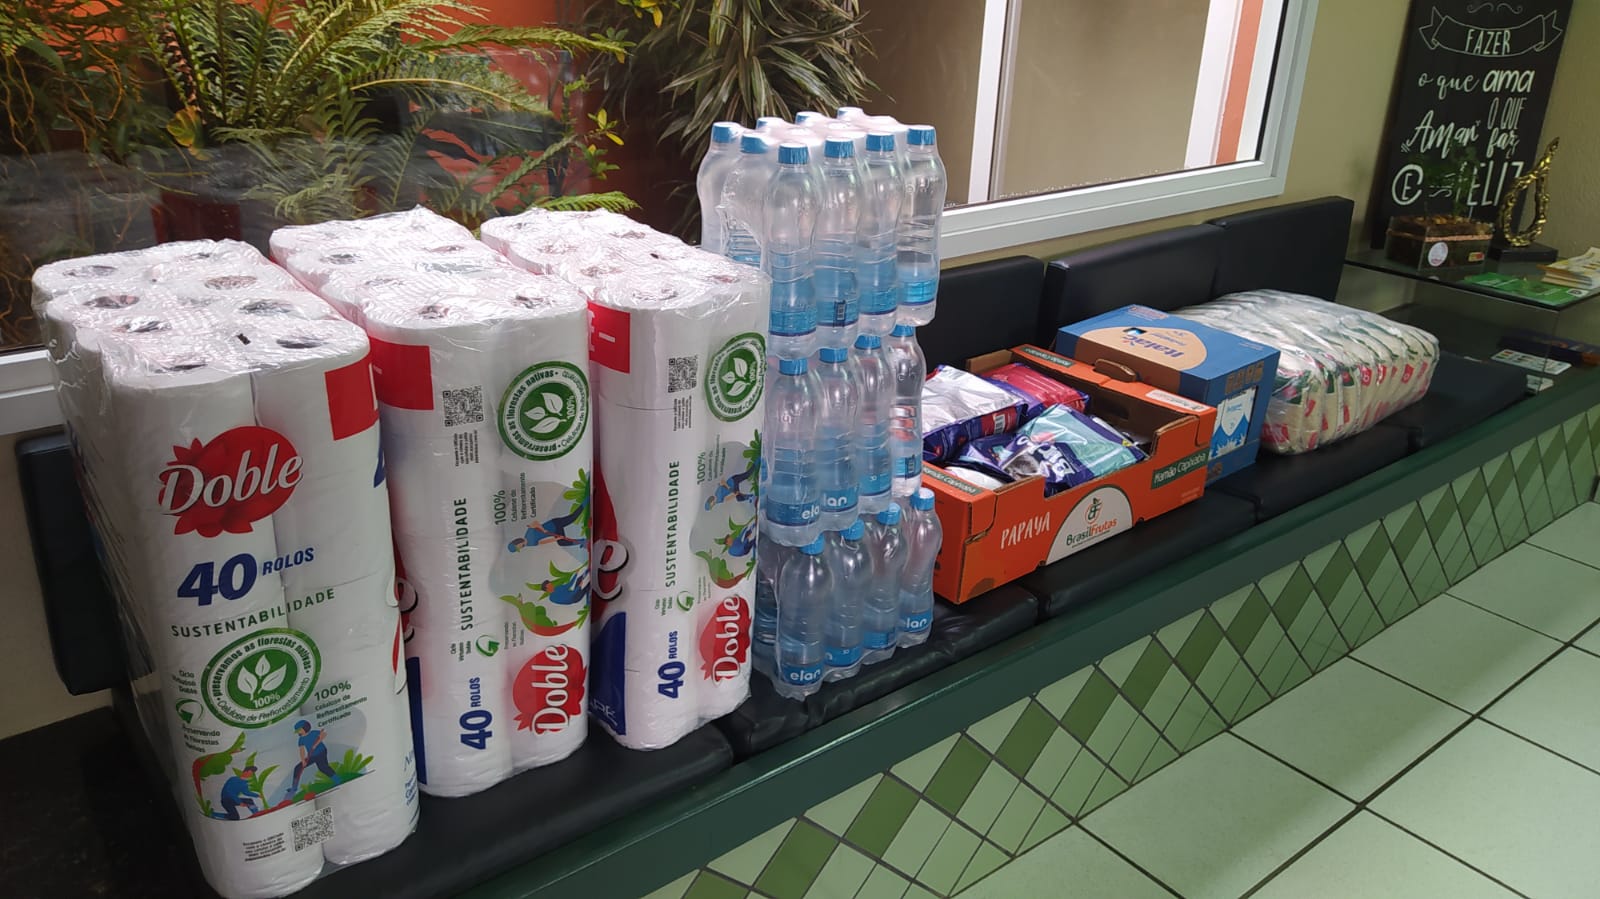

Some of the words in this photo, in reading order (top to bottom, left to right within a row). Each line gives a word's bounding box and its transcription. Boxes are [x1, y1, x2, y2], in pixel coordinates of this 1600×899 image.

[1465, 29, 1512, 56] FAZER
[1418, 72, 1433, 87] o
[1437, 74, 1480, 100] que
[1482, 69, 1536, 93] ama
[1487, 97, 1499, 130] O
[1501, 97, 1527, 130] QUE
[1486, 127, 1520, 159] faz
[157, 443, 304, 515] Doble
[697, 451, 707, 486] 100%
[493, 490, 506, 525] 100%
[801, 504, 820, 519] ela
[823, 493, 848, 507] lan
[665, 460, 680, 588] SUSTENTABILIDADE
[1000, 511, 1051, 550] PAPAYA
[177, 553, 257, 606] 40
[262, 548, 315, 576] ROLOS
[454, 498, 473, 631] SUSTENTABILIDADE
[171, 588, 335, 638] SUSTENTABILIDADE
[901, 617, 927, 629] lan
[668, 631, 678, 659] ROLOS
[712, 594, 741, 688] Doble
[211, 649, 243, 698] preservamos
[243, 643, 256, 653] as
[257, 636, 297, 648] florestas
[657, 661, 685, 699] 40
[252, 692, 281, 709] 100%
[314, 680, 352, 702] 100%
[469, 677, 480, 707] ROLOS
[531, 644, 570, 735] Doble
[459, 709, 492, 750] 40
